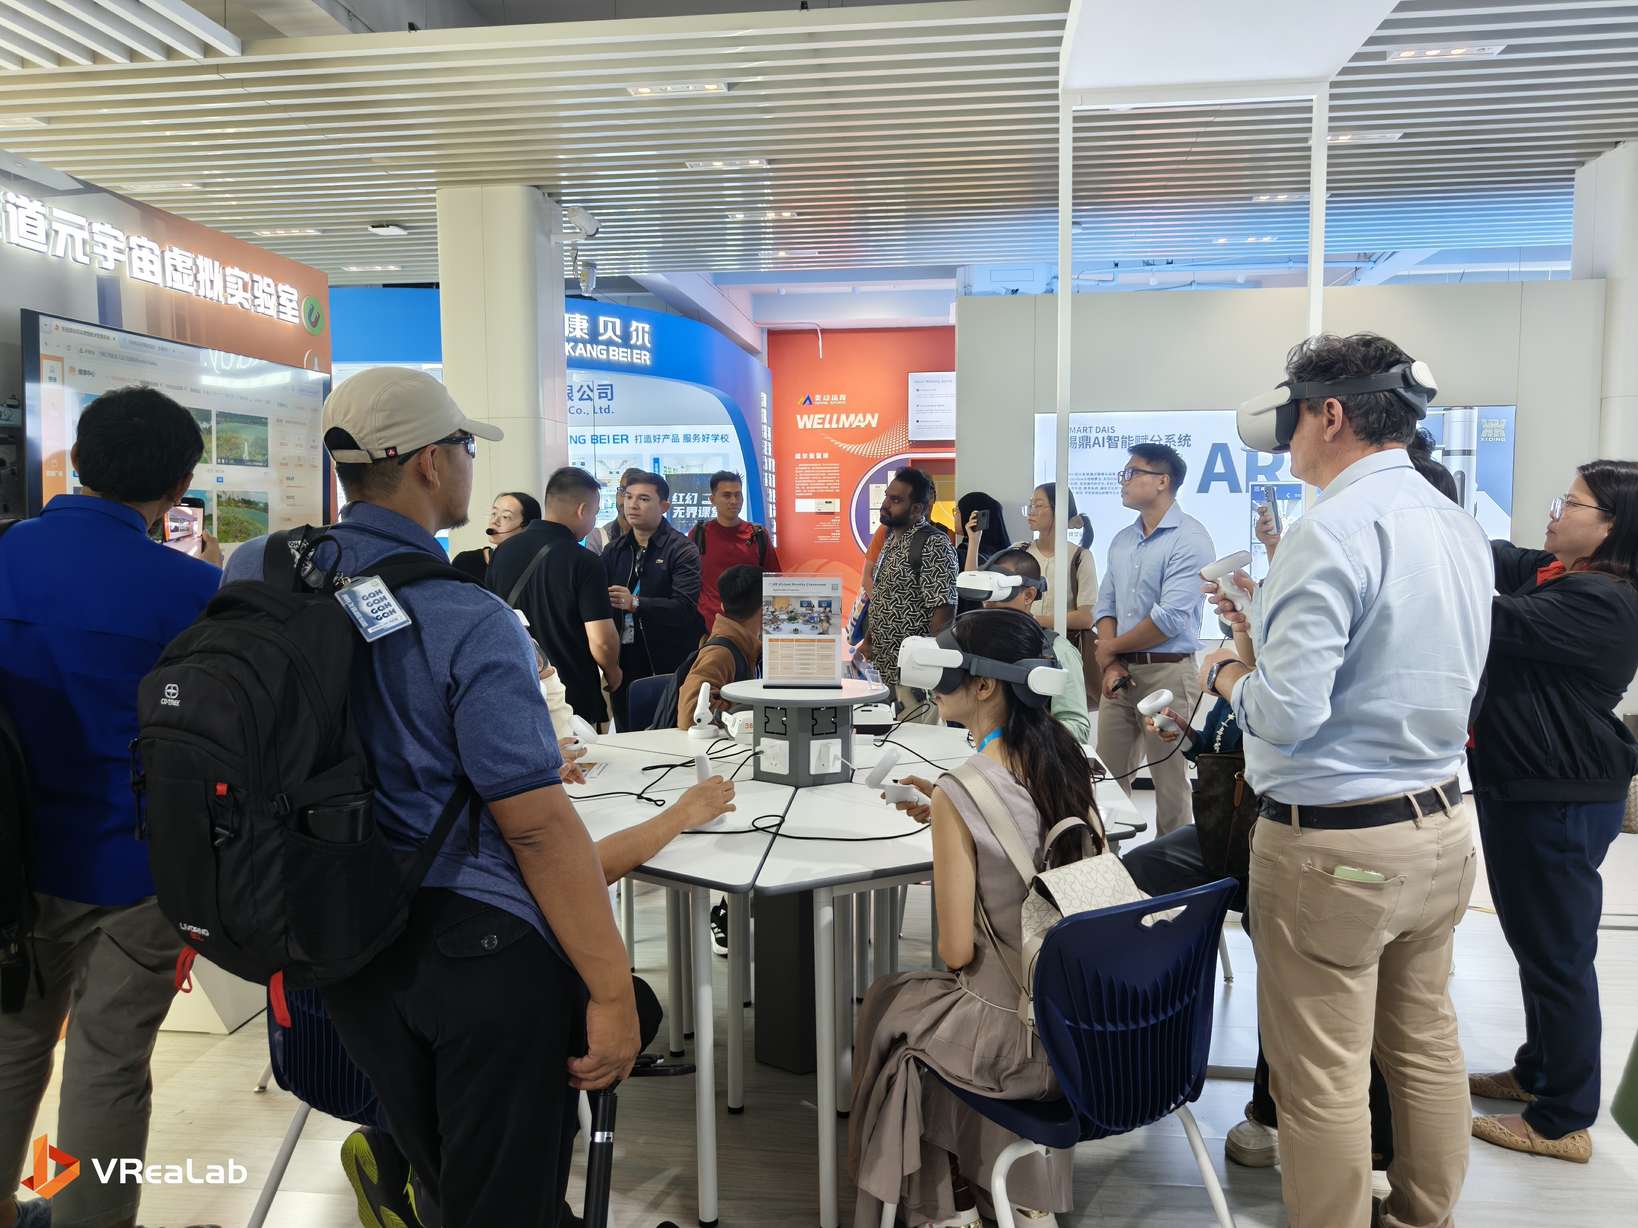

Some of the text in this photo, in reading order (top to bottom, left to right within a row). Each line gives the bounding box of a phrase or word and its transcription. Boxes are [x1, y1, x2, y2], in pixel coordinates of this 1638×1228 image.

[2, 191, 300, 325] 道元宇宙虚拟实验室
[564, 313, 651, 347] 康贝尔
[795, 412, 879, 430] WELLMAN
